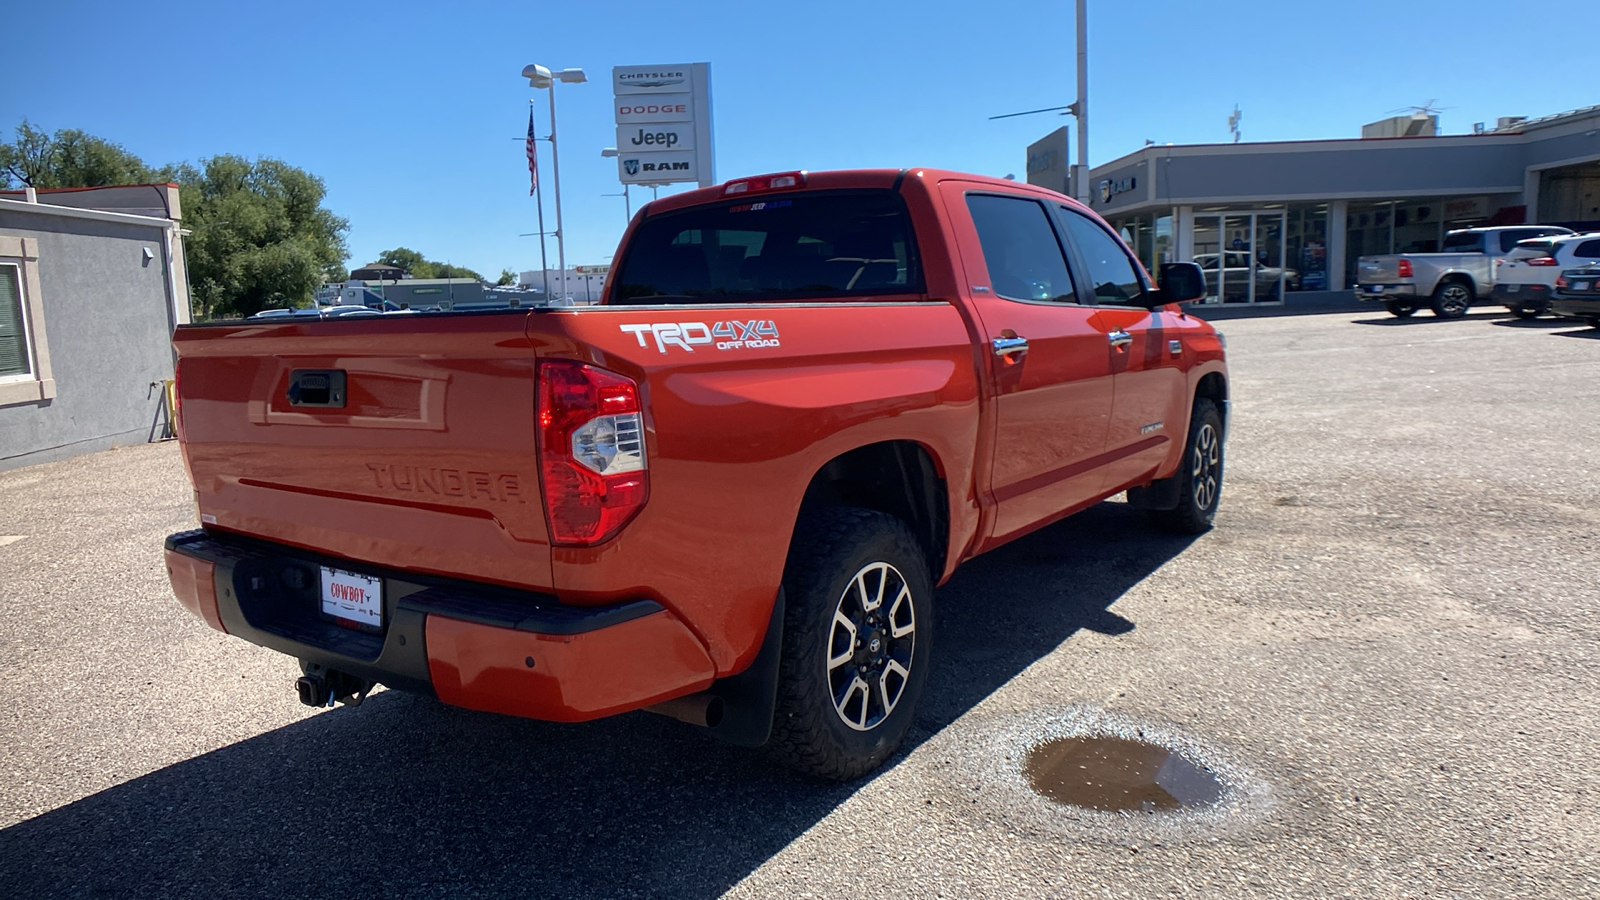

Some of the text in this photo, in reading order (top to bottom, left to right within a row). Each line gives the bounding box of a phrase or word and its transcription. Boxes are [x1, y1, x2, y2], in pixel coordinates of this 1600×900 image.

[620, 105, 686, 114] DODGE
[631, 129, 678, 147] Jeep
[643, 162, 689, 171] RAM
[619, 322, 714, 354] TRD
[717, 339, 780, 350] OFF ROAD
[366, 463, 526, 504] TUNDRA
[331, 582, 364, 604] COWBOY
